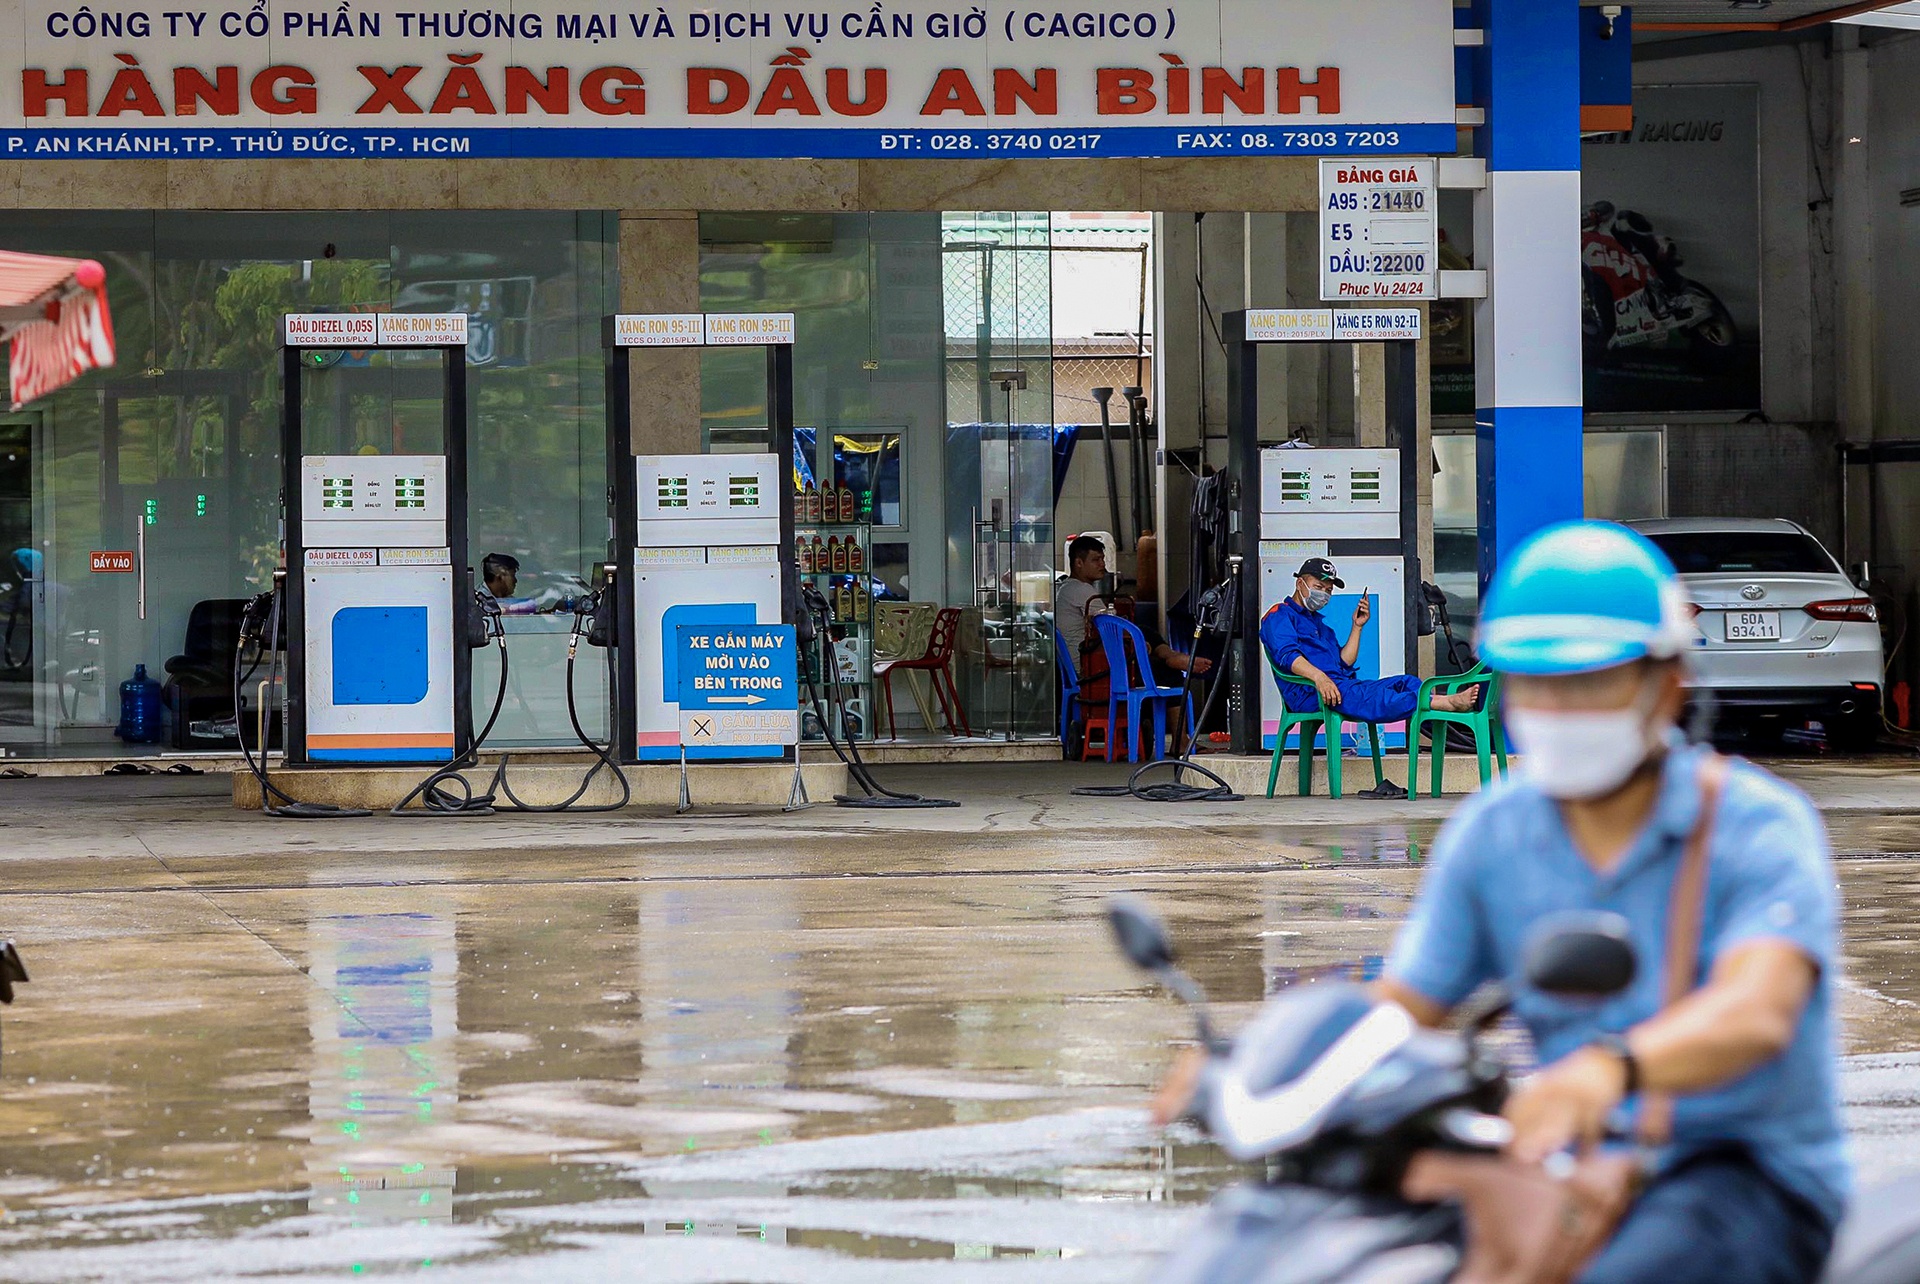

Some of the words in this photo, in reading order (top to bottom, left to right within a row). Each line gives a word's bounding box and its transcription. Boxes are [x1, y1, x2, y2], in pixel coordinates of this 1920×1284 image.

[46, 6, 150, 37] CÔNG
[163, 12, 207, 37] TY
[219, 0, 269, 37] CỔ
[283, 1, 381, 37] PHẦN
[396, 9, 542, 38] THƯƠNG
[556, 13, 617, 44] MẠI
[629, 8, 675, 38] VÀ
[689, 13, 771, 43] DỊCH
[784, 12, 829, 43] VỤ
[841, 2, 913, 38] CẦN
[926, 7, 987, 38] GIỜ
[22, 53, 317, 117] HÀNG
[355, 53, 645, 116] XĂNG
[686, 47, 887, 116] DẦU
[920, 67, 1057, 116] AN
[1096, 53, 1340, 116] BÌNH
[1639, 120, 1724, 142] RACING
[8, 137, 28, 153] P.
[35, 137, 70, 153] AN
[231, 130, 283, 153] THỦ
[292, 132, 356, 154] ĐỨC,
[363, 137, 402, 153] TP.
[412, 136, 470, 153] HCM
[880, 134, 921, 150] ĐT:
[930, 134, 979, 150] 028.
[987, 134, 1042, 150] 3740
[1048, 134, 1101, 150] 0217
[1177, 132, 1231, 149] FAX:
[1241, 133, 1275, 149] 08.
[1283, 132, 1337, 148] 7303
[1346, 131, 1399, 147] 7203
[1337, 165, 1384, 183] BẢNG
[1389, 166, 1418, 183] GIÁ
[1372, 192, 1424, 210] 21440
[1373, 254, 1425, 272] 22200
[1339, 282, 1370, 297] Phục
[1374, 282, 1389, 297] Vụ
[1392, 282, 1424, 295] 24/24
[289, 315, 309, 333] DẦU
[311, 320, 344, 333] DIEZEL
[347, 319, 373, 335] 0,05S
[382, 316, 409, 332] XĂNG
[412, 318, 432, 332] RON
[619, 318, 646, 334] XĂNG
[649, 320, 669, 333] RON
[710, 317, 736, 333] XĂNG
[739, 319, 759, 332] RON
[1250, 313, 1276, 329] XĂNG
[1279, 314, 1298, 328] RON
[1336, 313, 1359, 329] XĂNG
[1361, 315, 1372, 329] E5
[1375, 315, 1392, 329] RON
[112, 555, 130, 568] VÀO
[326, 552, 351, 560] DIEZEL
[1741, 613, 1765, 625] 60A
[1732, 625, 1774, 637] 934.11
[690, 636, 710, 649] XE
[714, 630, 747, 649] GẮN
[751, 632, 785, 648] MÁY
[705, 653, 734, 669] MỜI
[738, 653, 770, 669] VÀO
[694, 674, 725, 689] BÊN
[730, 677, 782, 689] TRONG
